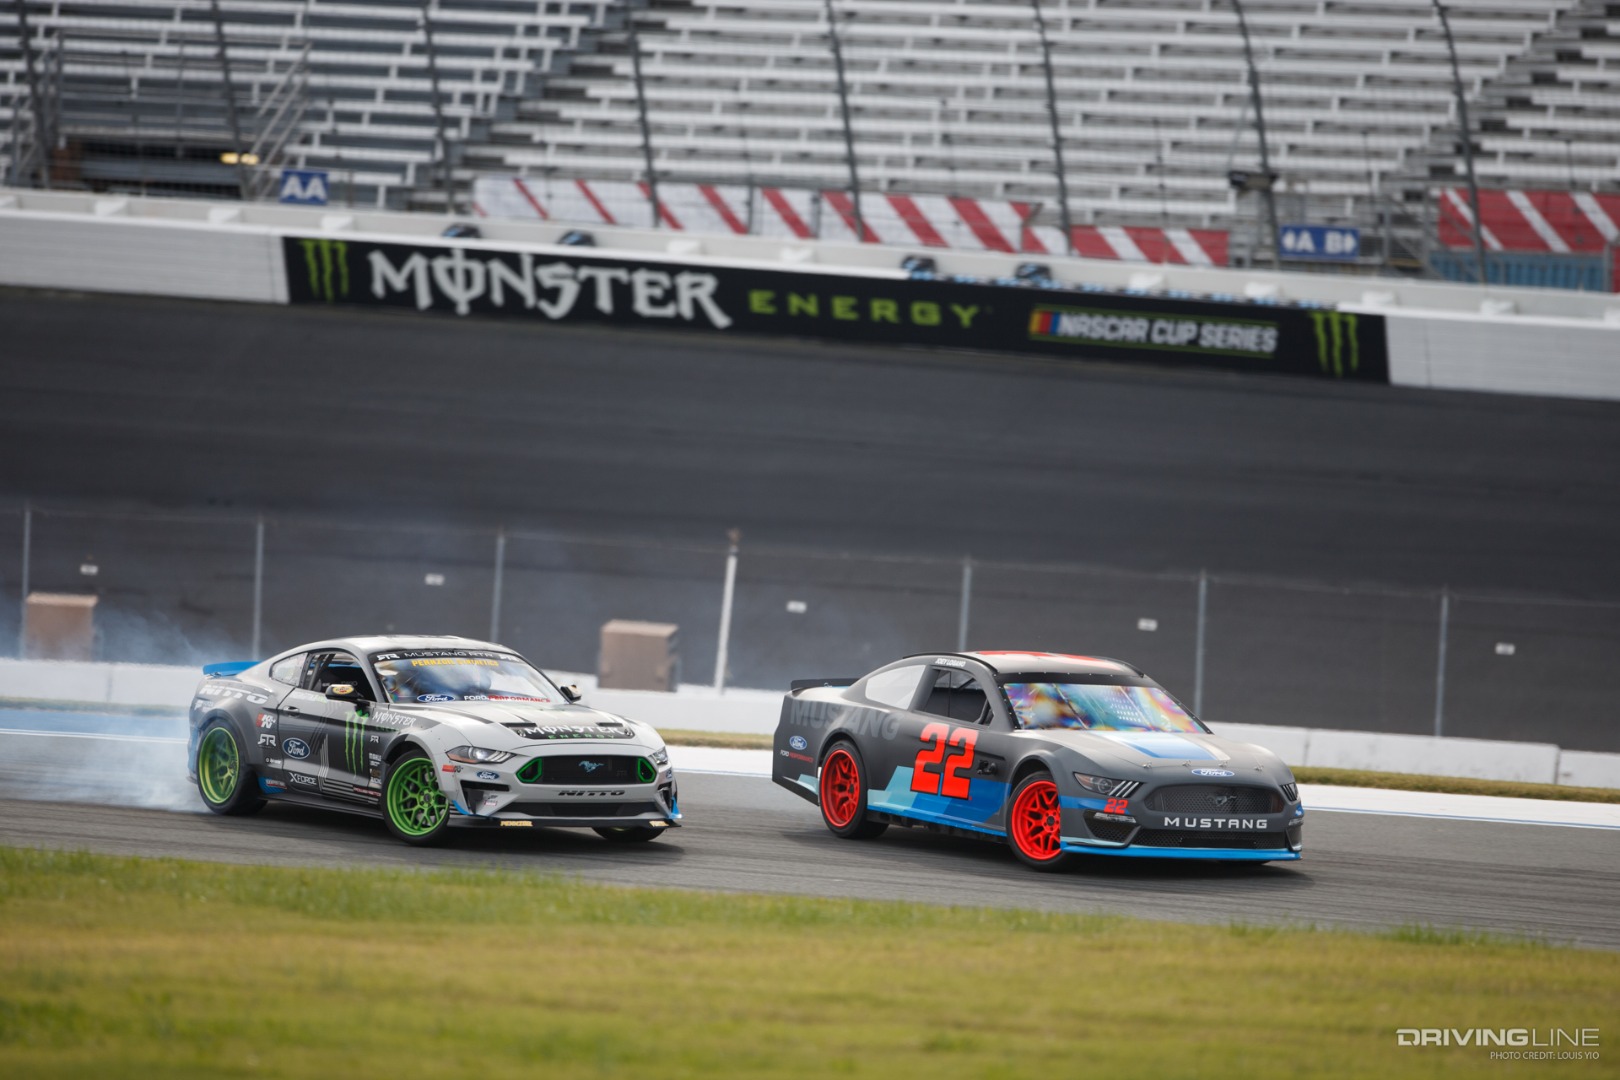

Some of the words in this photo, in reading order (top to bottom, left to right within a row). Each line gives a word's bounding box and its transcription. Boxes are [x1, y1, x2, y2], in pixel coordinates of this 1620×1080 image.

[281, 174, 327, 199] AA
[1296, 230, 1315, 252] A
[1325, 231, 1342, 254] B
[368, 248, 732, 328] MONSTER
[749, 289, 979, 329] ENERGY
[1058, 312, 1148, 343] NASCAR
[1150, 320, 1197, 345] CUP
[1200, 325, 1279, 353] SERIES
[411, 659, 456, 667] PENNZOIL
[199, 684, 269, 705] NITTO
[372, 711, 416, 728] MONSTER
[524, 724, 625, 735] MONSTER
[790, 699, 904, 740] MUSTANG
[287, 740, 306, 756] Ford
[910, 722, 979, 801] 22
[1103, 797, 1129, 815] 22
[1164, 816, 1268, 829] MUSTANG
